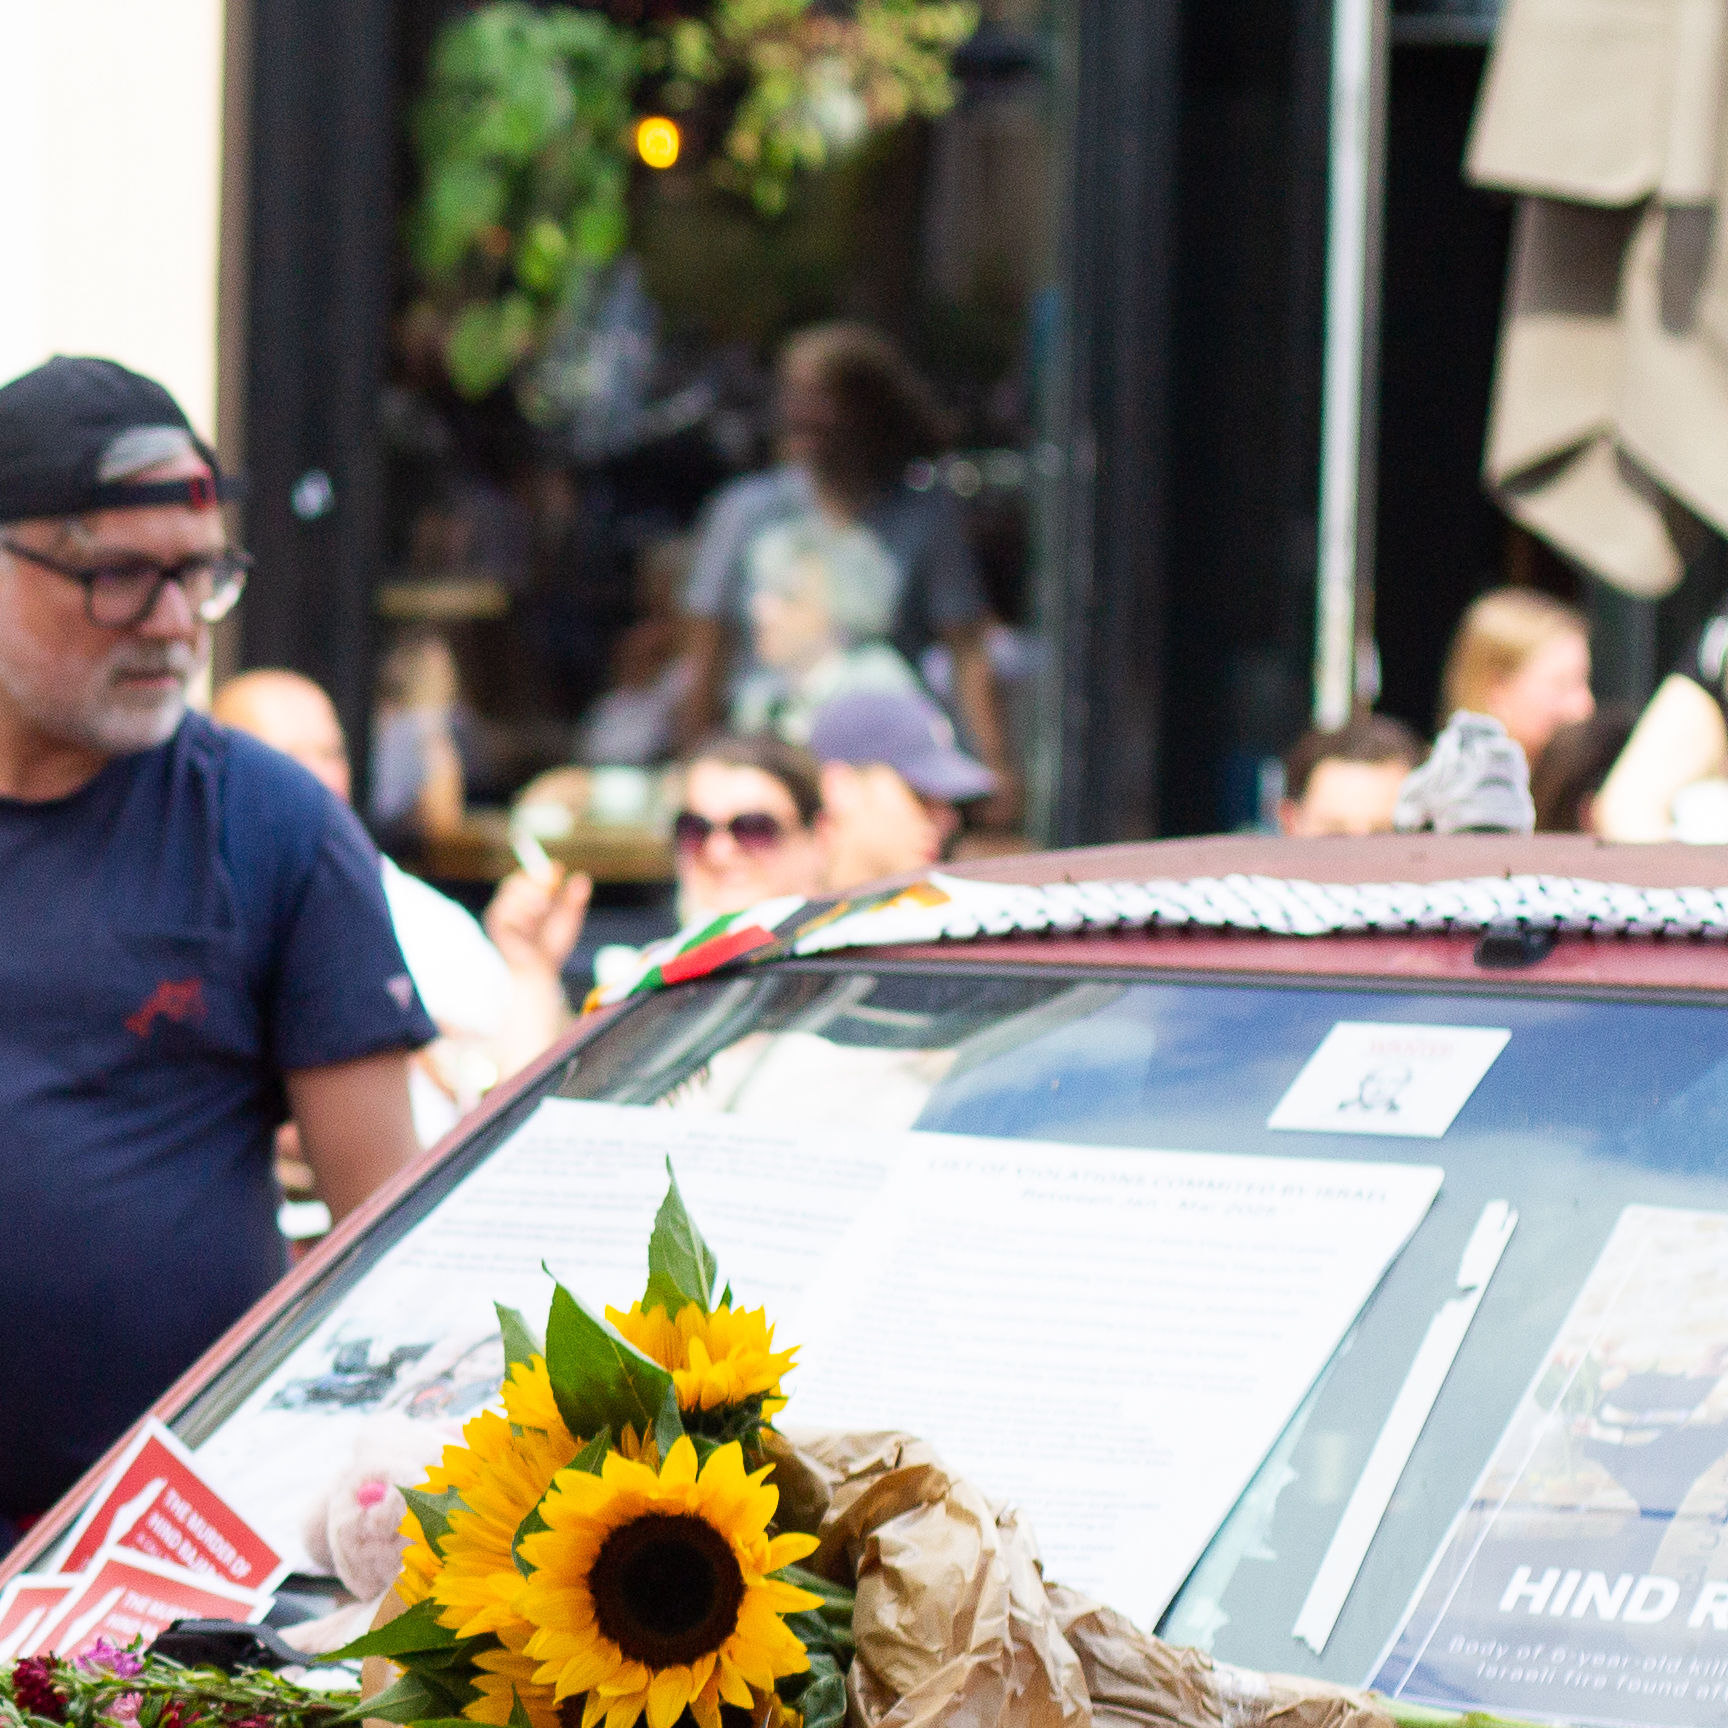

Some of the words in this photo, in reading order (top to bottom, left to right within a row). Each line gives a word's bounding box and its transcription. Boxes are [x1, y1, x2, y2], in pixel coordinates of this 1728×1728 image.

[146, 1511, 182, 1550] HIND
[164, 1487, 193, 1523] THE
[186, 1511, 237, 1567] MURDER
[229, 1555, 253, 1579] OF
[124, 1590, 149, 1613] THE
[1498, 1564, 1681, 1625] HIND
[1448, 1635, 1509, 1661] Body
[1516, 1643, 1545, 1661] of
[1551, 1645, 1683, 1675] 6-year-old
[1476, 1659, 1557, 1685] Israeli
[1564, 1668, 1608, 1691] fire
[1616, 1674, 1690, 1698] found
